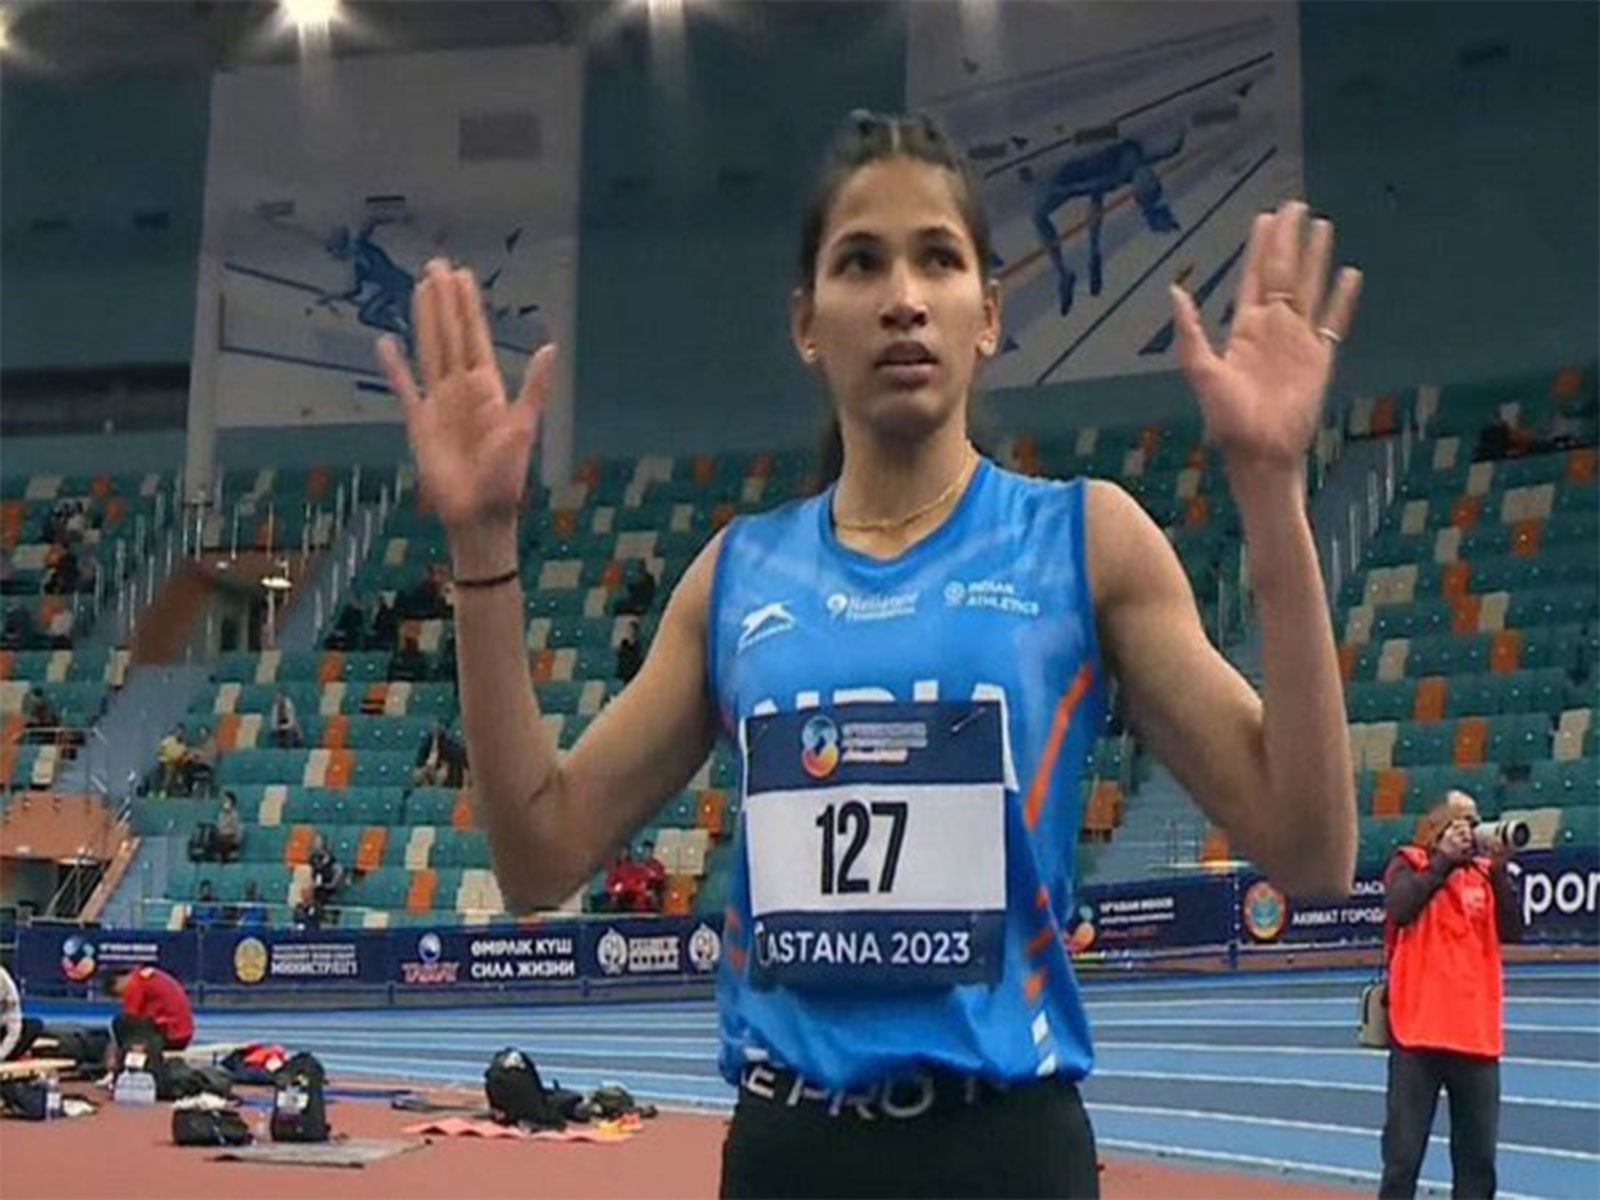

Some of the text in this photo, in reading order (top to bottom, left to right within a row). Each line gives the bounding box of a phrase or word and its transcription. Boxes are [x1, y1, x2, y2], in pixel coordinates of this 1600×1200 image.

[966, 596, 1039, 618] ATHLETICS
[815, 800, 908, 896] 127
[767, 931, 971, 964] ASTANA 2023
[470, 961, 515, 979] СИЛА
[516, 960, 575, 978] ЖИЗНИ
